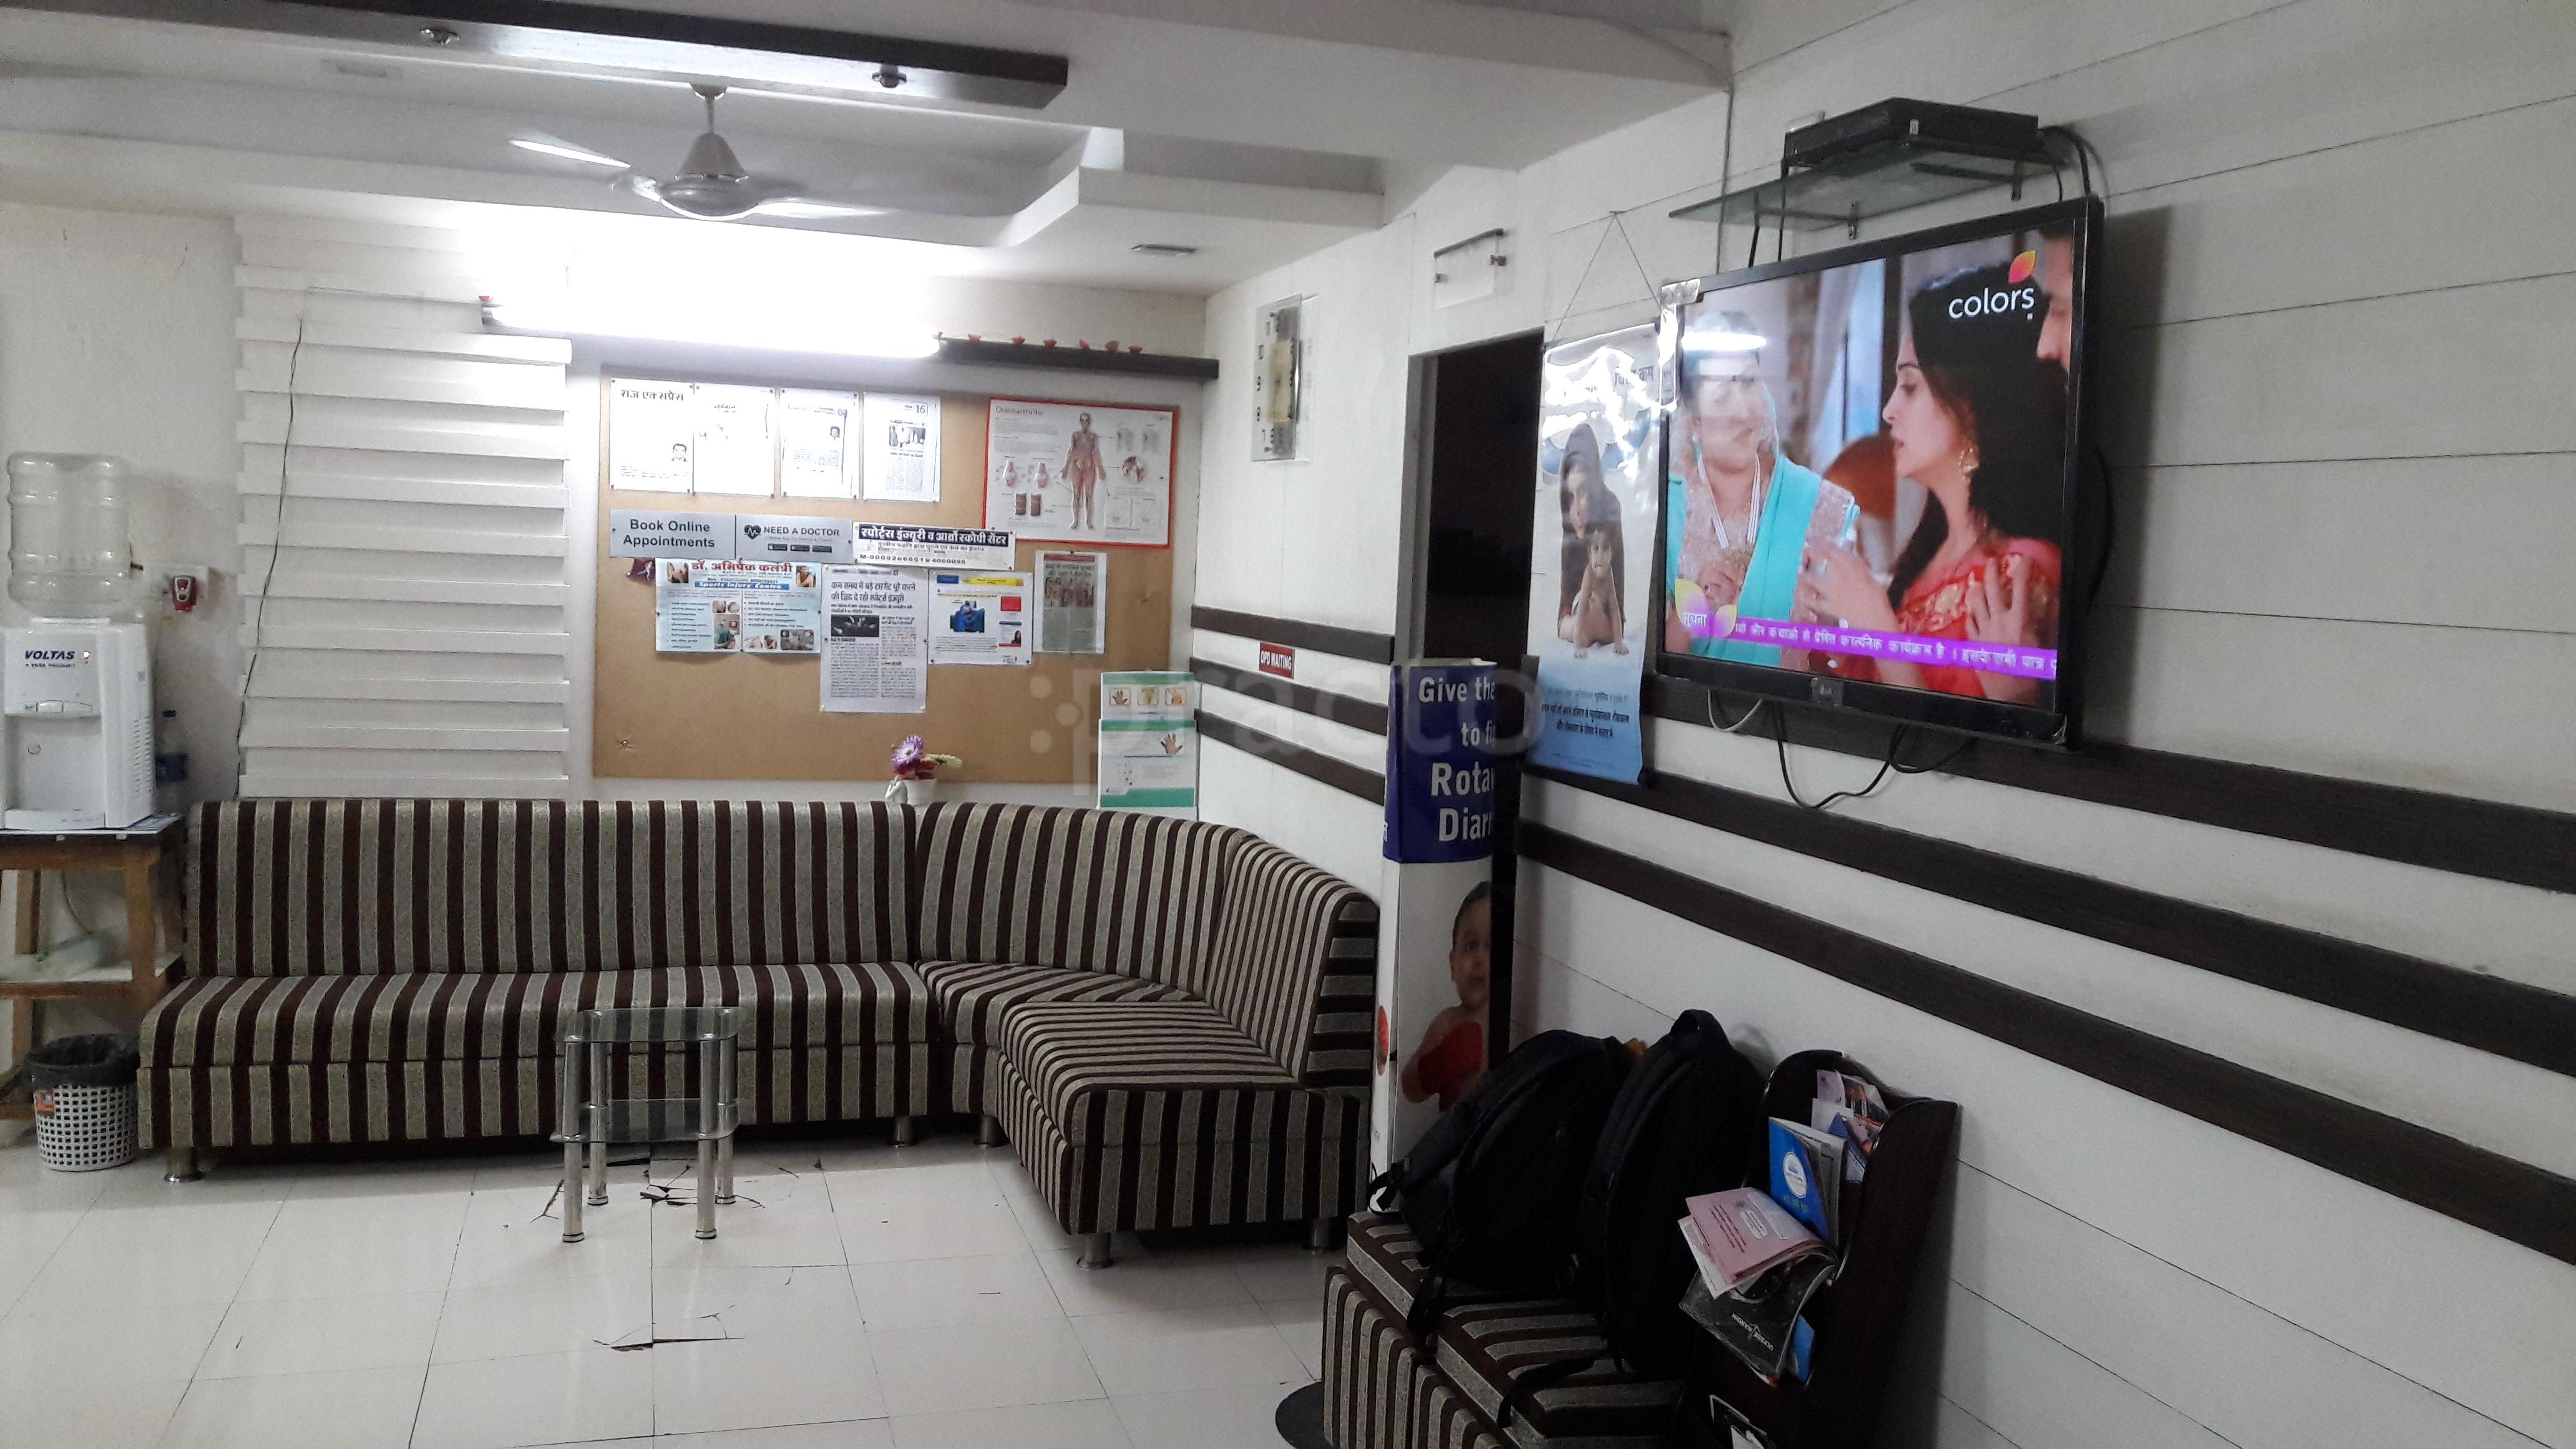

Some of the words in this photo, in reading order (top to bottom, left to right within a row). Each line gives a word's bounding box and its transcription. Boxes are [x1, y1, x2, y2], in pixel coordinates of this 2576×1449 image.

[1948, 287, 2035, 320] colors
[630, 519, 663, 531] Book
[668, 520, 710, 532] Online
[764, 526, 789, 534] NEED
[791, 527, 799, 535] A
[801, 527, 839, 536] DOCTOR
[623, 535, 715, 548] Appointments
[24, 650, 76, 660] VOLTAS
[1261, 650, 1271, 665] OPD
[1271, 652, 1292, 670] WAITING
[1418, 676, 1468, 703] Give
[1460, 722, 1480, 748] to
